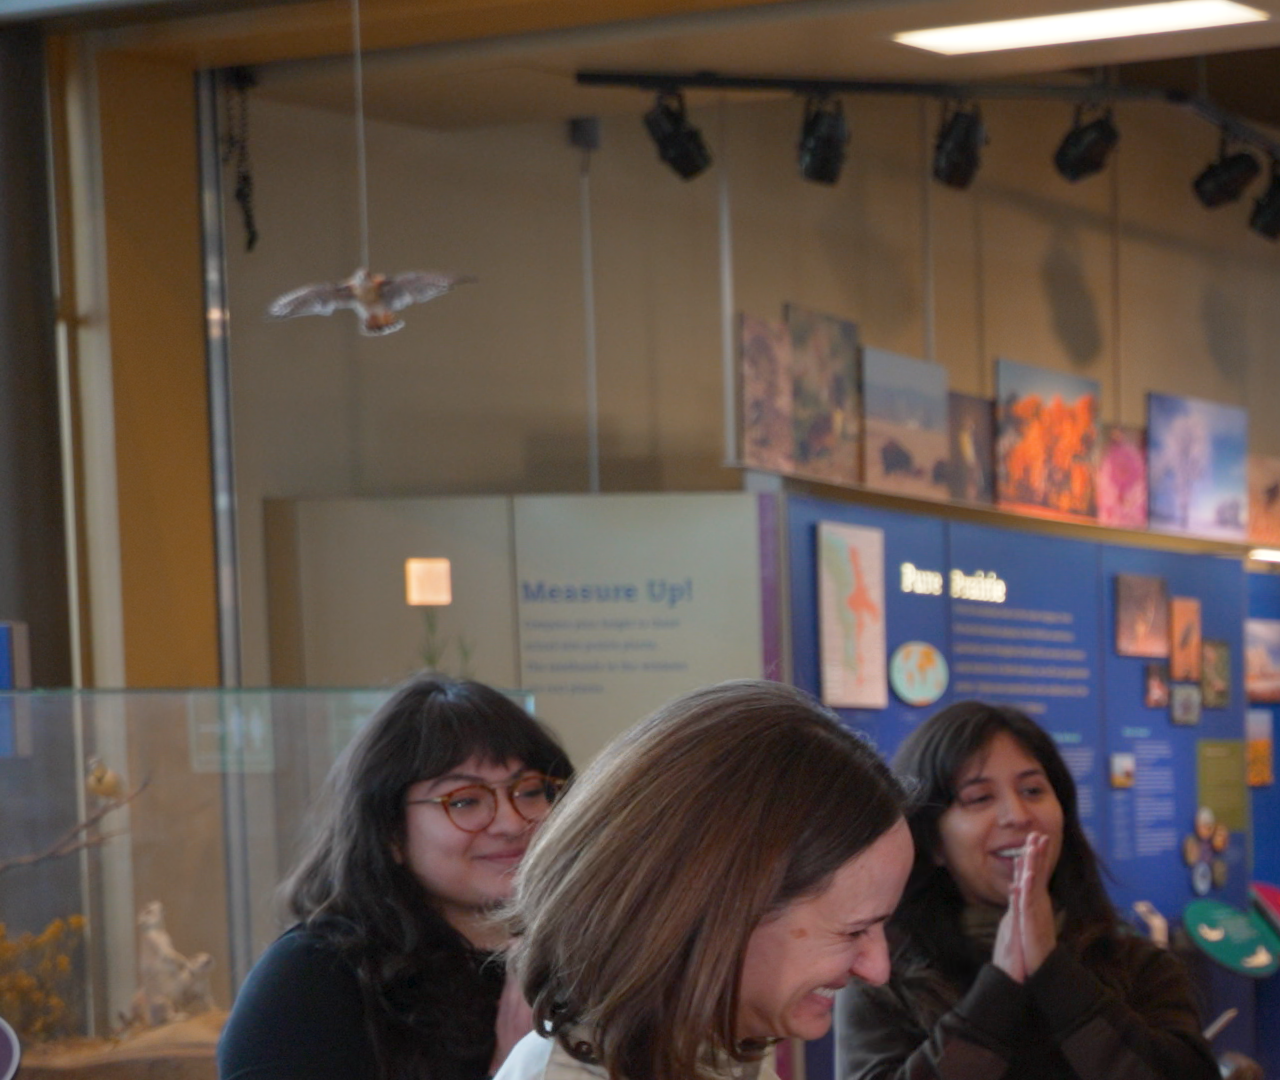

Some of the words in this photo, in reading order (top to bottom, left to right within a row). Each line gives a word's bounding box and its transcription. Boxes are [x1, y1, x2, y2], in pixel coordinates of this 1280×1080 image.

[521, 578, 638, 603] Measure
[646, 575, 694, 609] Up!
[900, 561, 944, 596] Pure
